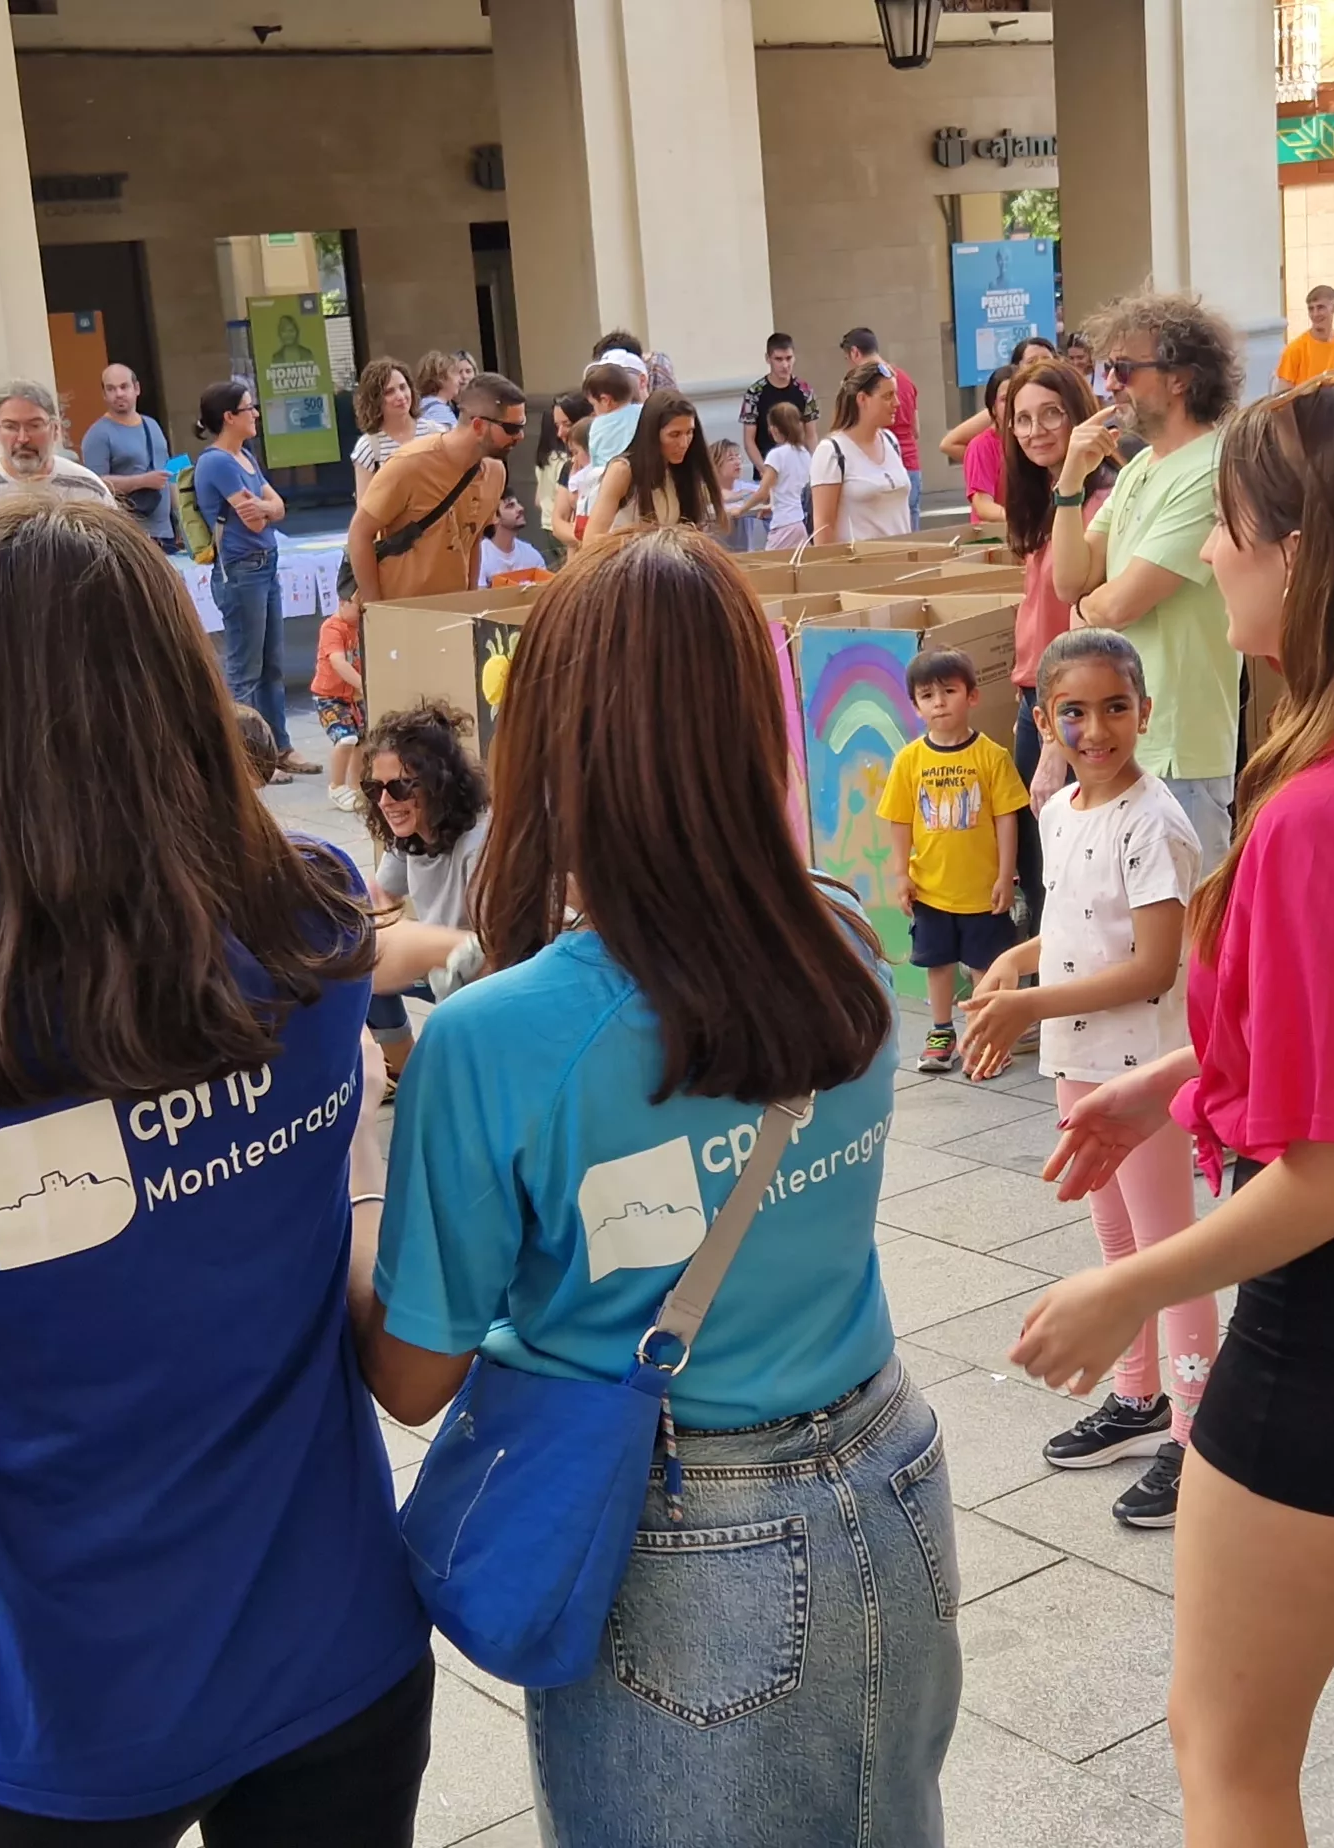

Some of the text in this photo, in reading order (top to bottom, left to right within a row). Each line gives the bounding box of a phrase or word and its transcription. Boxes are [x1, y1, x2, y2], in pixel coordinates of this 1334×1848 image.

[973, 128, 1057, 167] cajam
[1013, 326, 1031, 341] 500
[304, 397, 324, 411] 500
[922, 765, 963, 778] WAITING
[935, 776, 966, 788] WAVES
